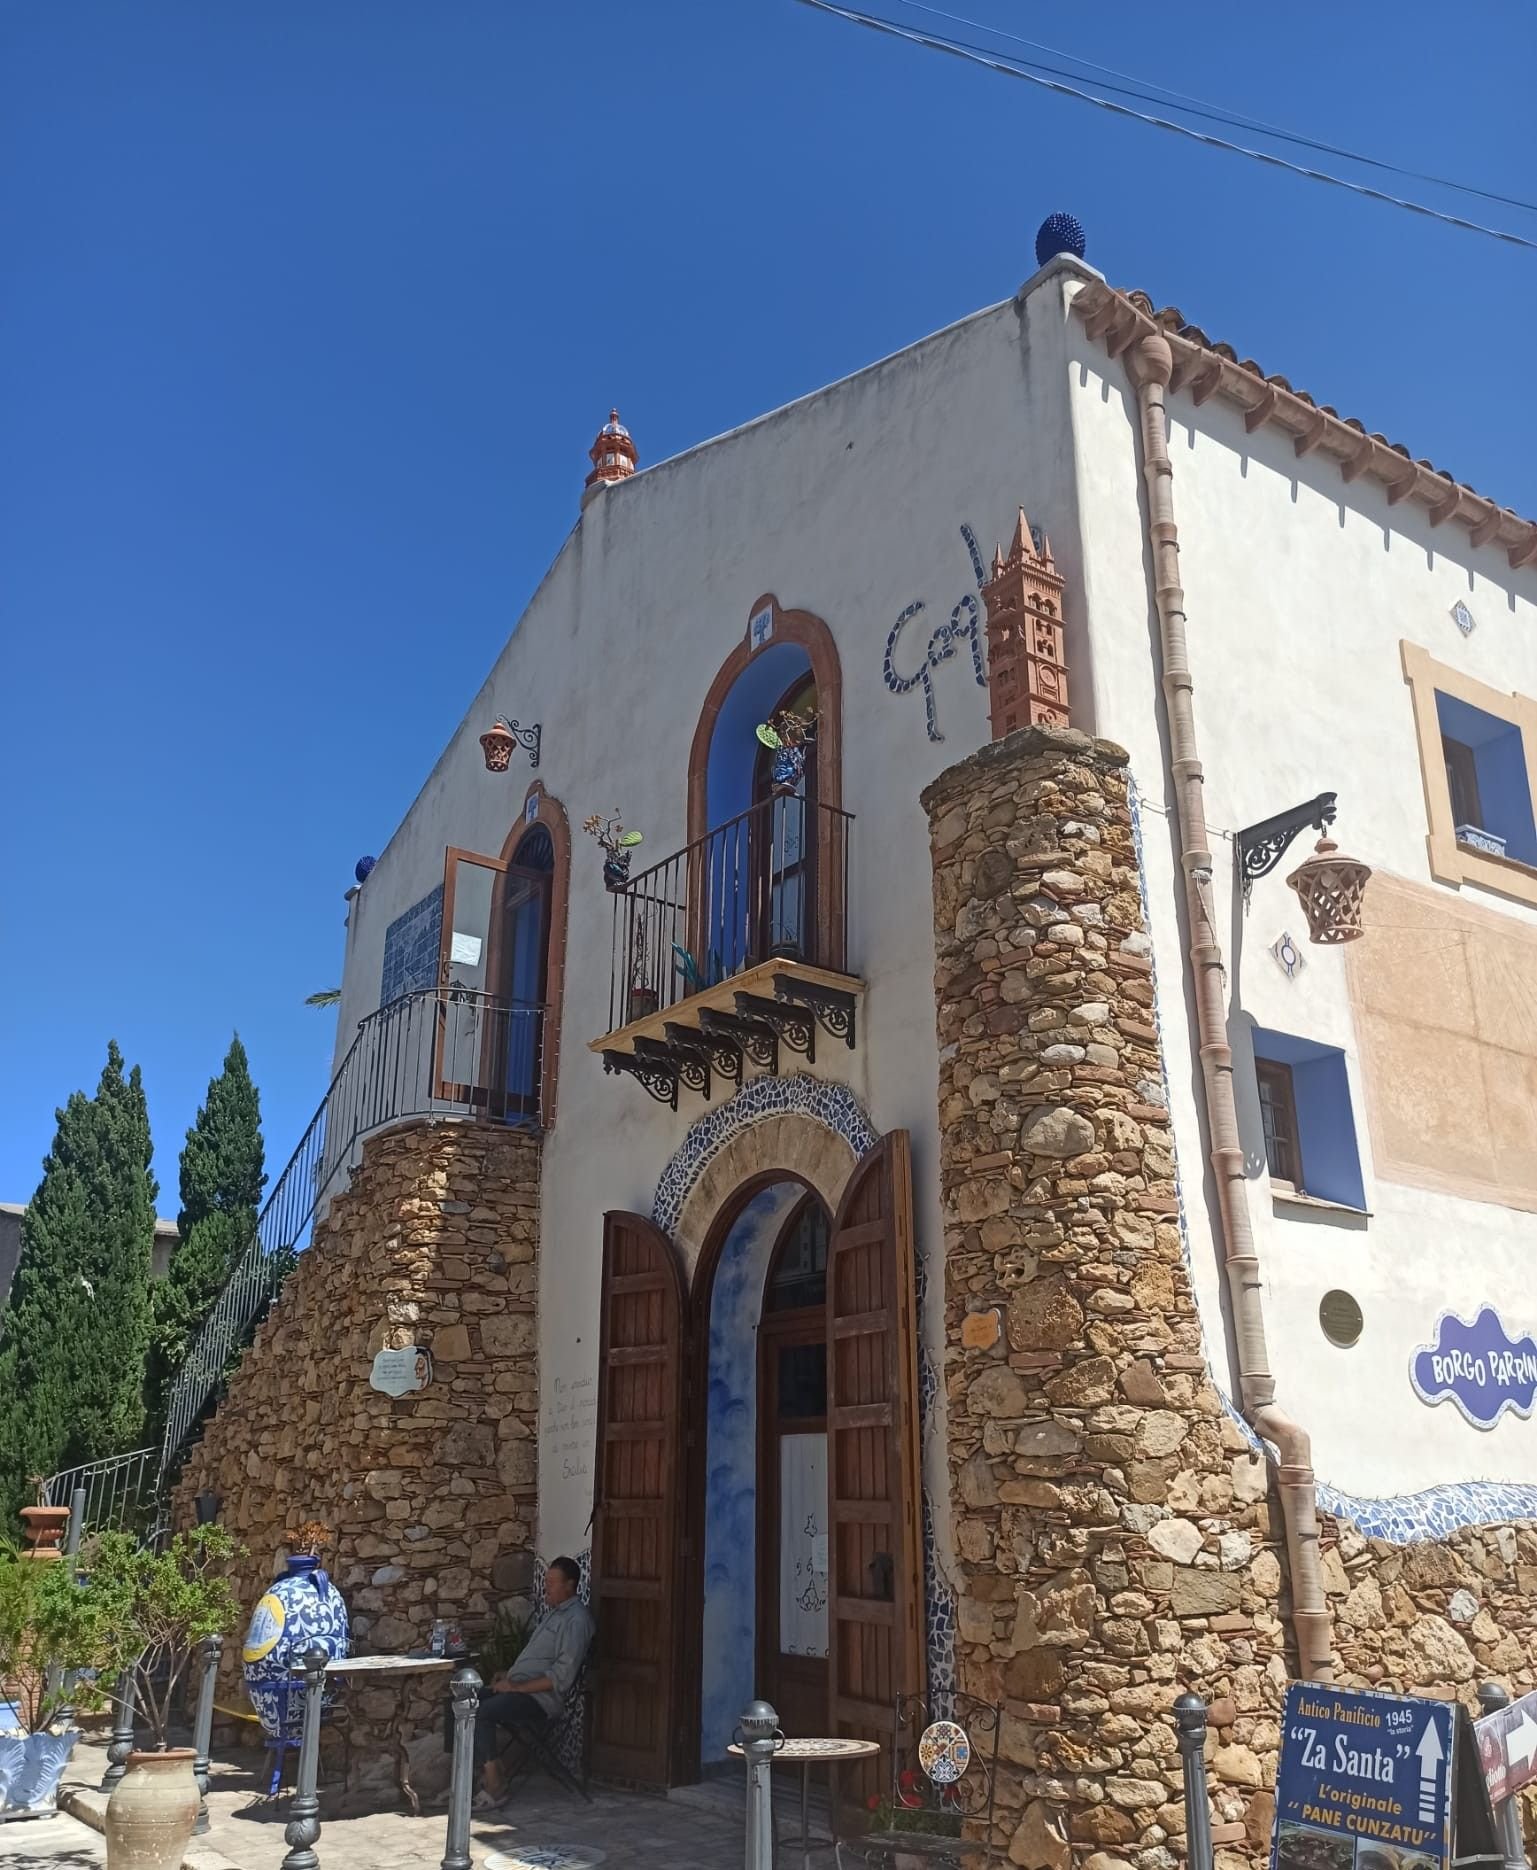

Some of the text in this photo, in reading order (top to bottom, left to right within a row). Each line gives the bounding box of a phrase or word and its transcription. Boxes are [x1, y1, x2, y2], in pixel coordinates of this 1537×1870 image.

[1431, 1349, 1486, 1387] BORGO
[1297, 1697, 1381, 1728] Antico Panificio
[1385, 1709, 1413, 1727] 1945
[1318, 1783, 1403, 1815] L'originale
